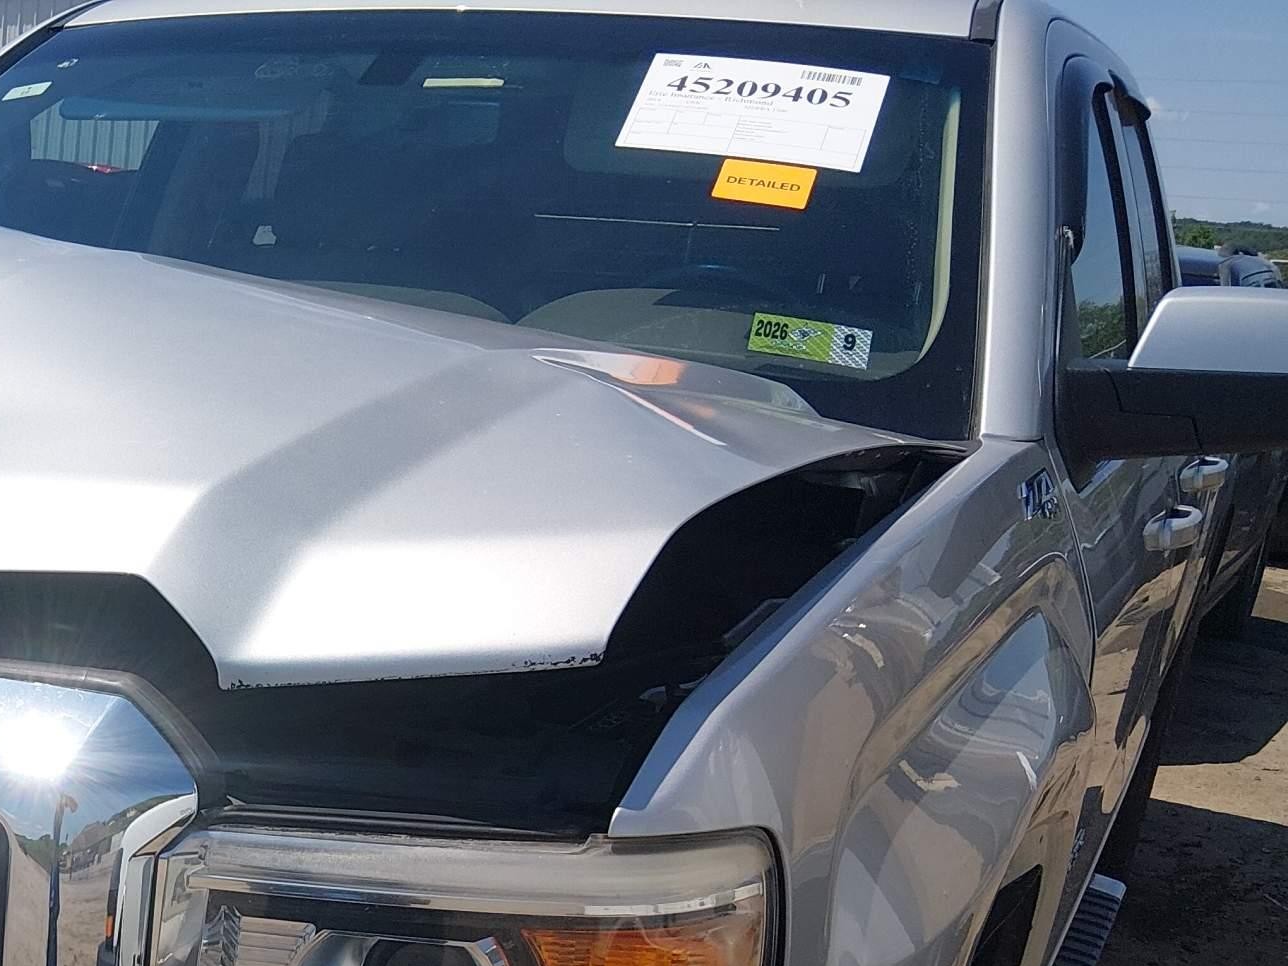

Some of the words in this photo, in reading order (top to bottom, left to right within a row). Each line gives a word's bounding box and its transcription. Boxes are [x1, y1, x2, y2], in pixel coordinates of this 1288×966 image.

[667, 75, 854, 109] 45209405
[725, 175, 802, 193] DETAILED
[754, 319, 789, 341] 2026
[842, 332, 857, 351] 9
